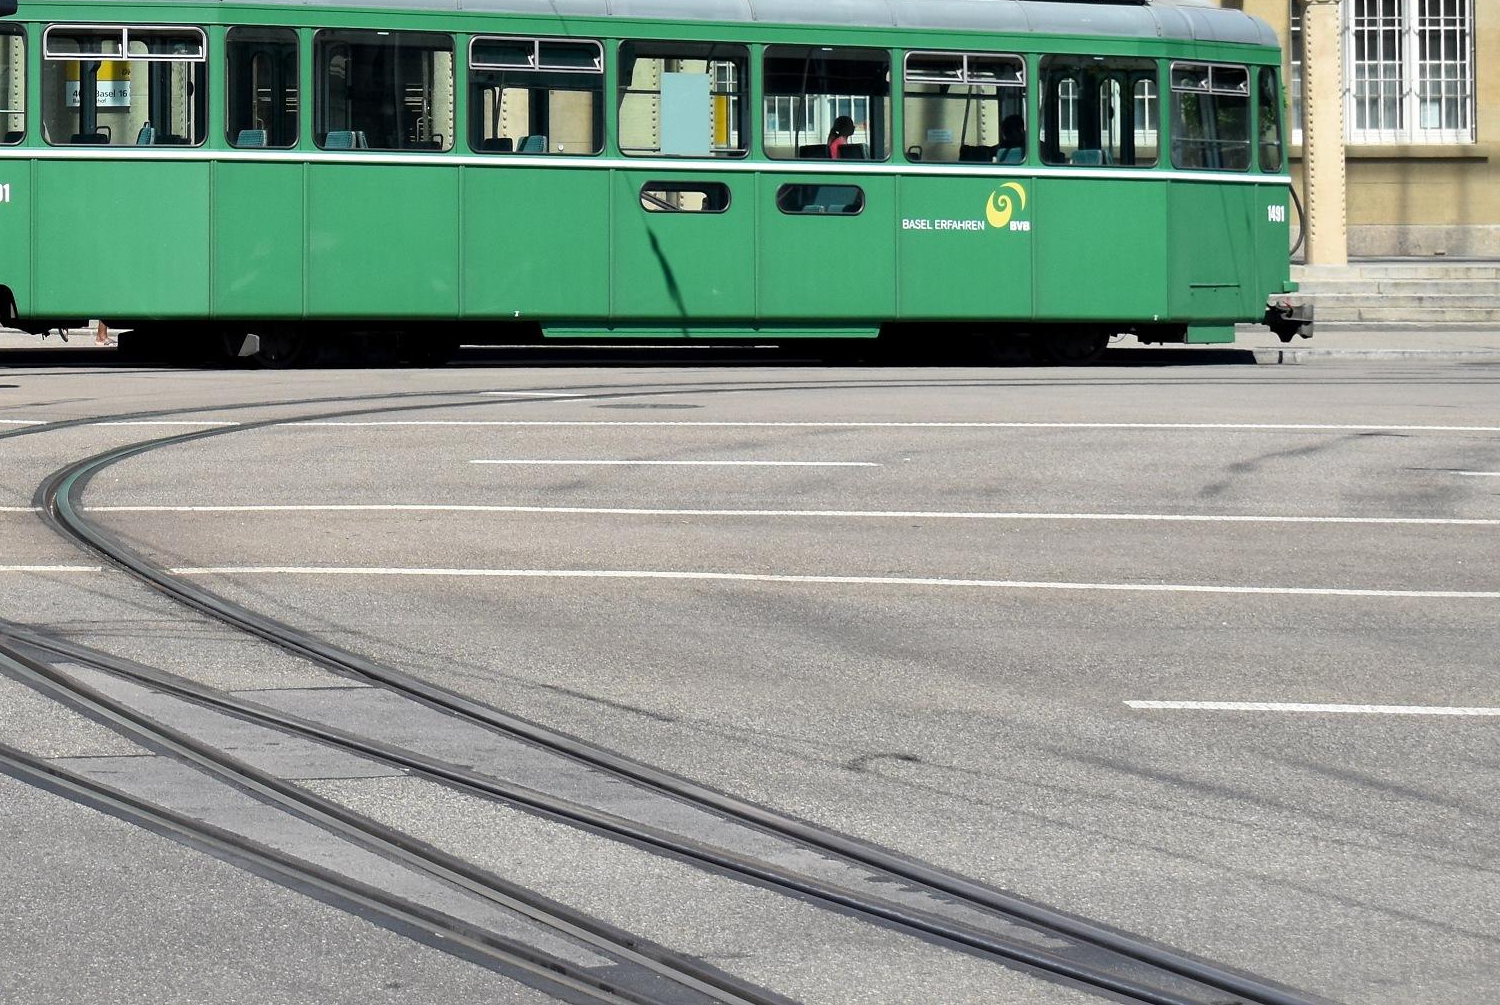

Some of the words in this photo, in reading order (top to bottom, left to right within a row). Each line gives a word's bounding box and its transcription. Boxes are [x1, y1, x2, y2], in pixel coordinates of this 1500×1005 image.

[1267, 205, 1285, 222] 1491
[902, 219, 933, 230] BASEL
[934, 219, 985, 231] ERFAHREN
[1009, 221, 1030, 231] BVB
